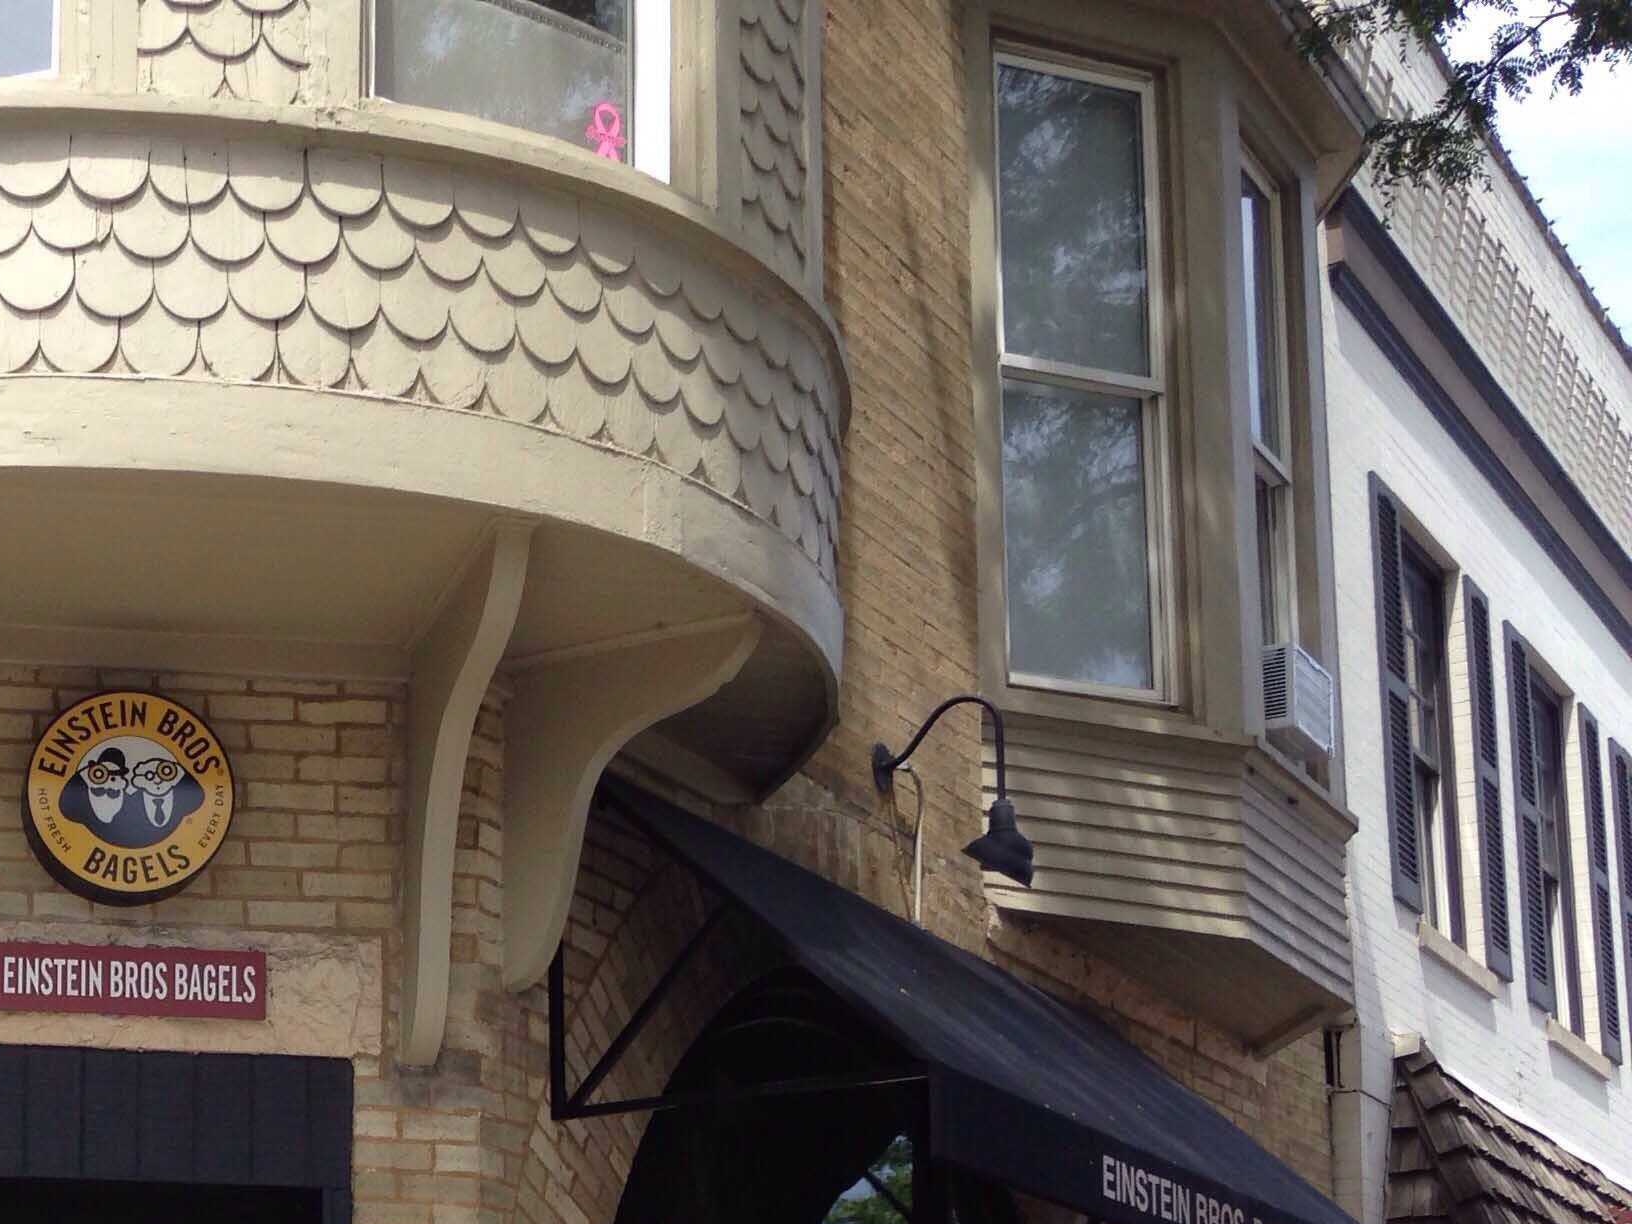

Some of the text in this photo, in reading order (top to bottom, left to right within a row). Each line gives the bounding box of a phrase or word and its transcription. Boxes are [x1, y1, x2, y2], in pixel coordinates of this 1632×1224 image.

[37, 699, 219, 778] EINSTEIN BROS
[37, 786, 72, 853] HOT FRESH
[197, 783, 225, 850] EVERY DAY
[83, 844, 191, 885] BAGELS
[2, 956, 257, 1004] EINSTEIN BROS BAGELS
